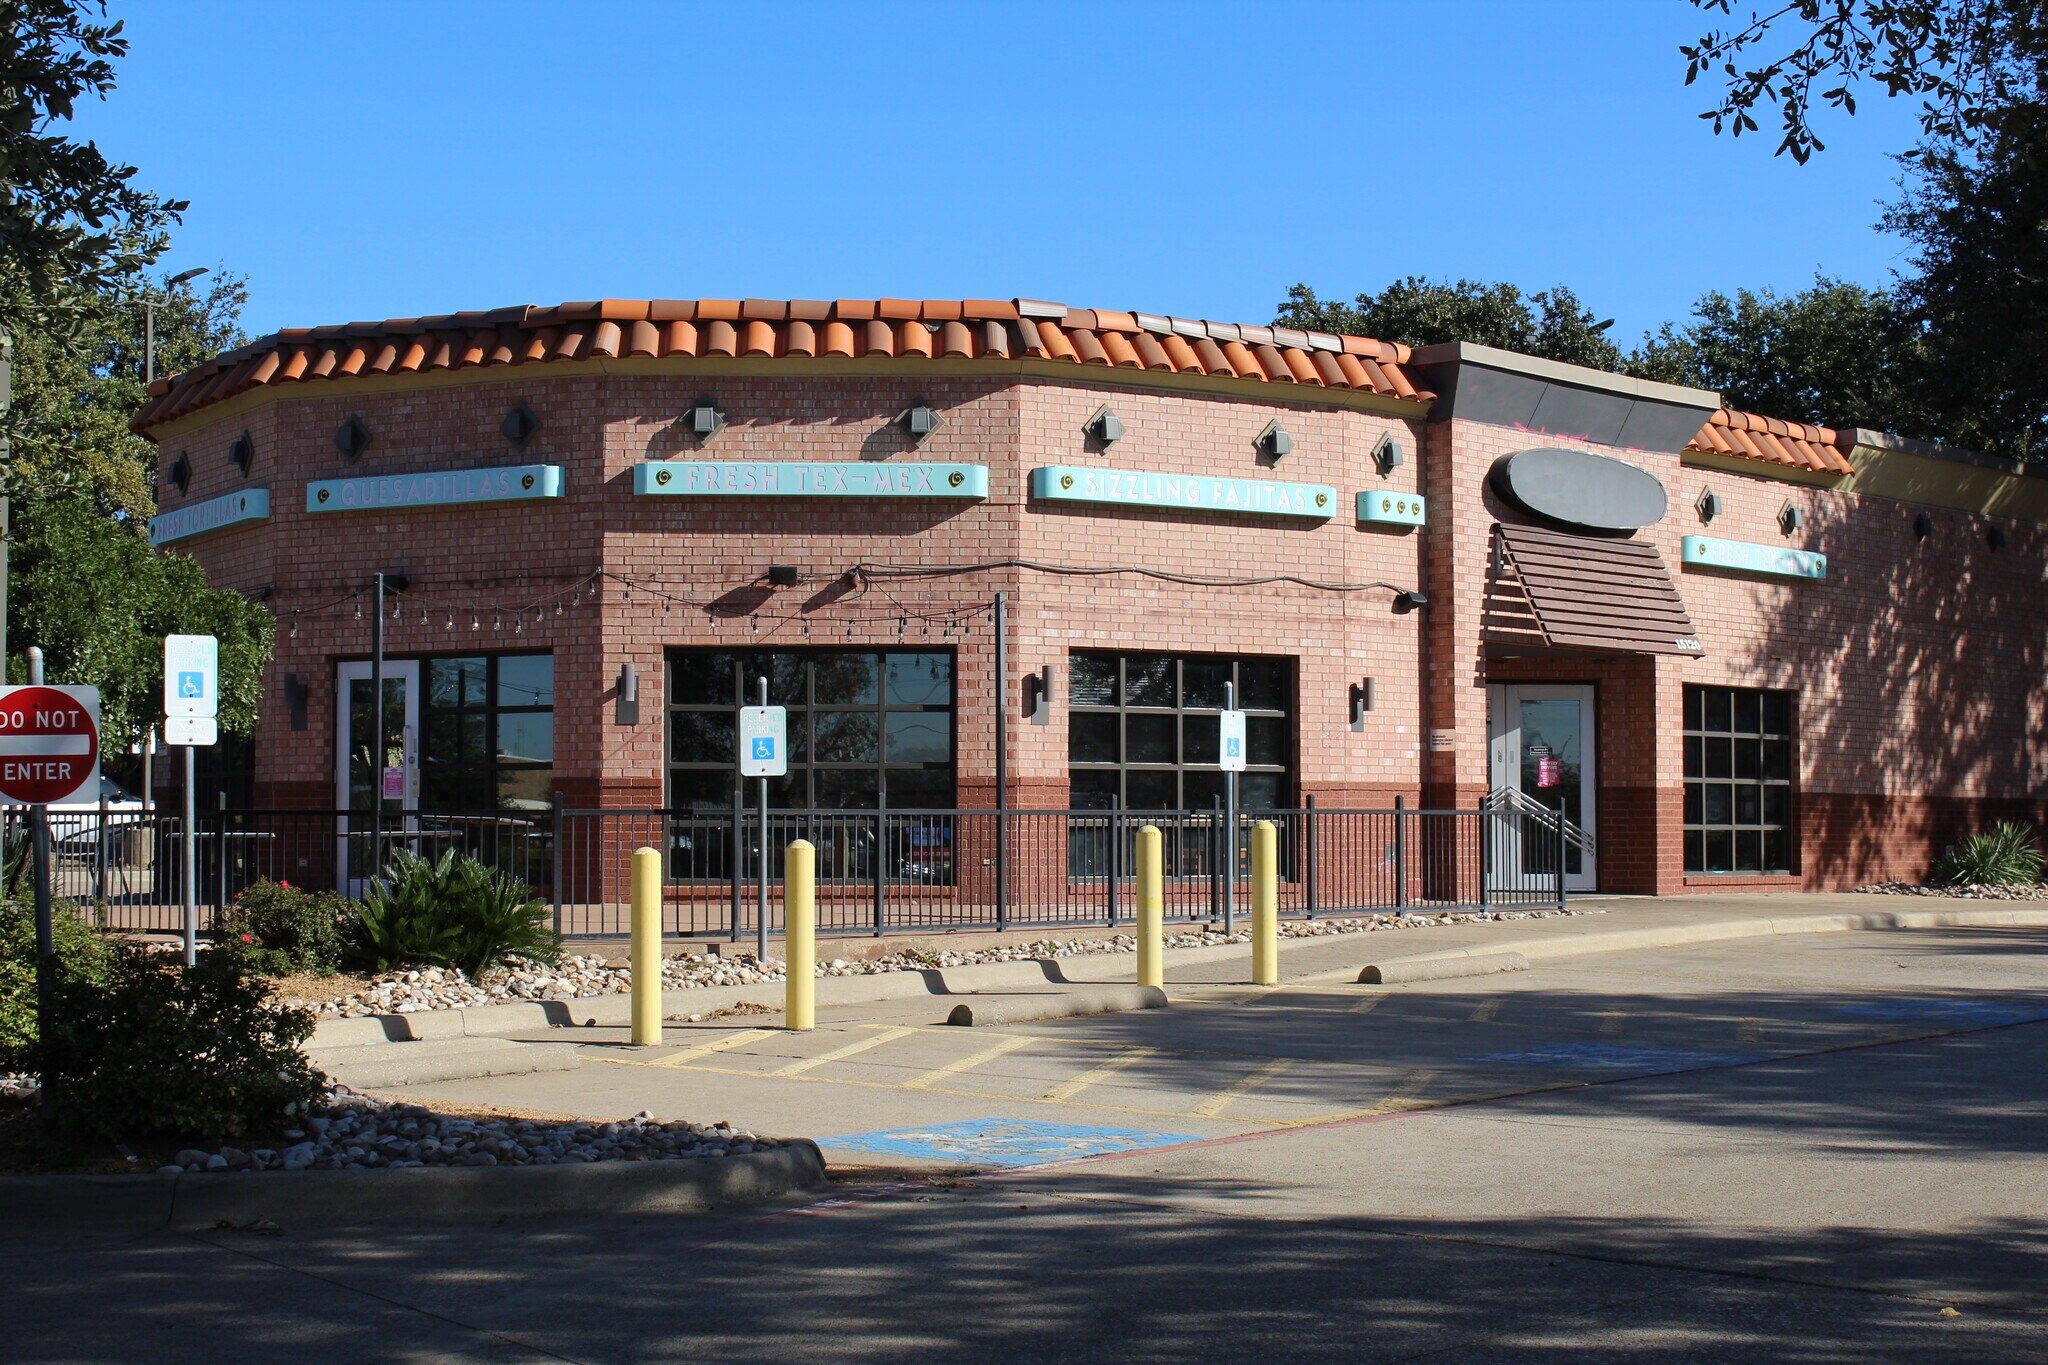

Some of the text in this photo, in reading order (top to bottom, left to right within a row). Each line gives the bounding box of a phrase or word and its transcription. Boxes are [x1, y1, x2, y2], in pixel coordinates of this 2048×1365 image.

[687, 465, 934, 493] FRESH TEX-MEX
[341, 471, 510, 507] QUESADILLAS
[1085, 471, 1306, 512] SIZZLING FAJITAS
[158, 495, 238, 540] FRESH TORTILLAS
[1711, 541, 1752, 565] FRESH
[169, 643, 214, 655] RESERVED
[1674, 638, 1701, 651] 15120
[174, 657, 209, 669] PARKING
[36, 710, 79, 728] NOT
[743, 713, 783, 723] RESERVED
[180, 723, 203, 733] VAN
[747, 725, 779, 735] PARKING
[4, 762, 72, 781] ENTER
